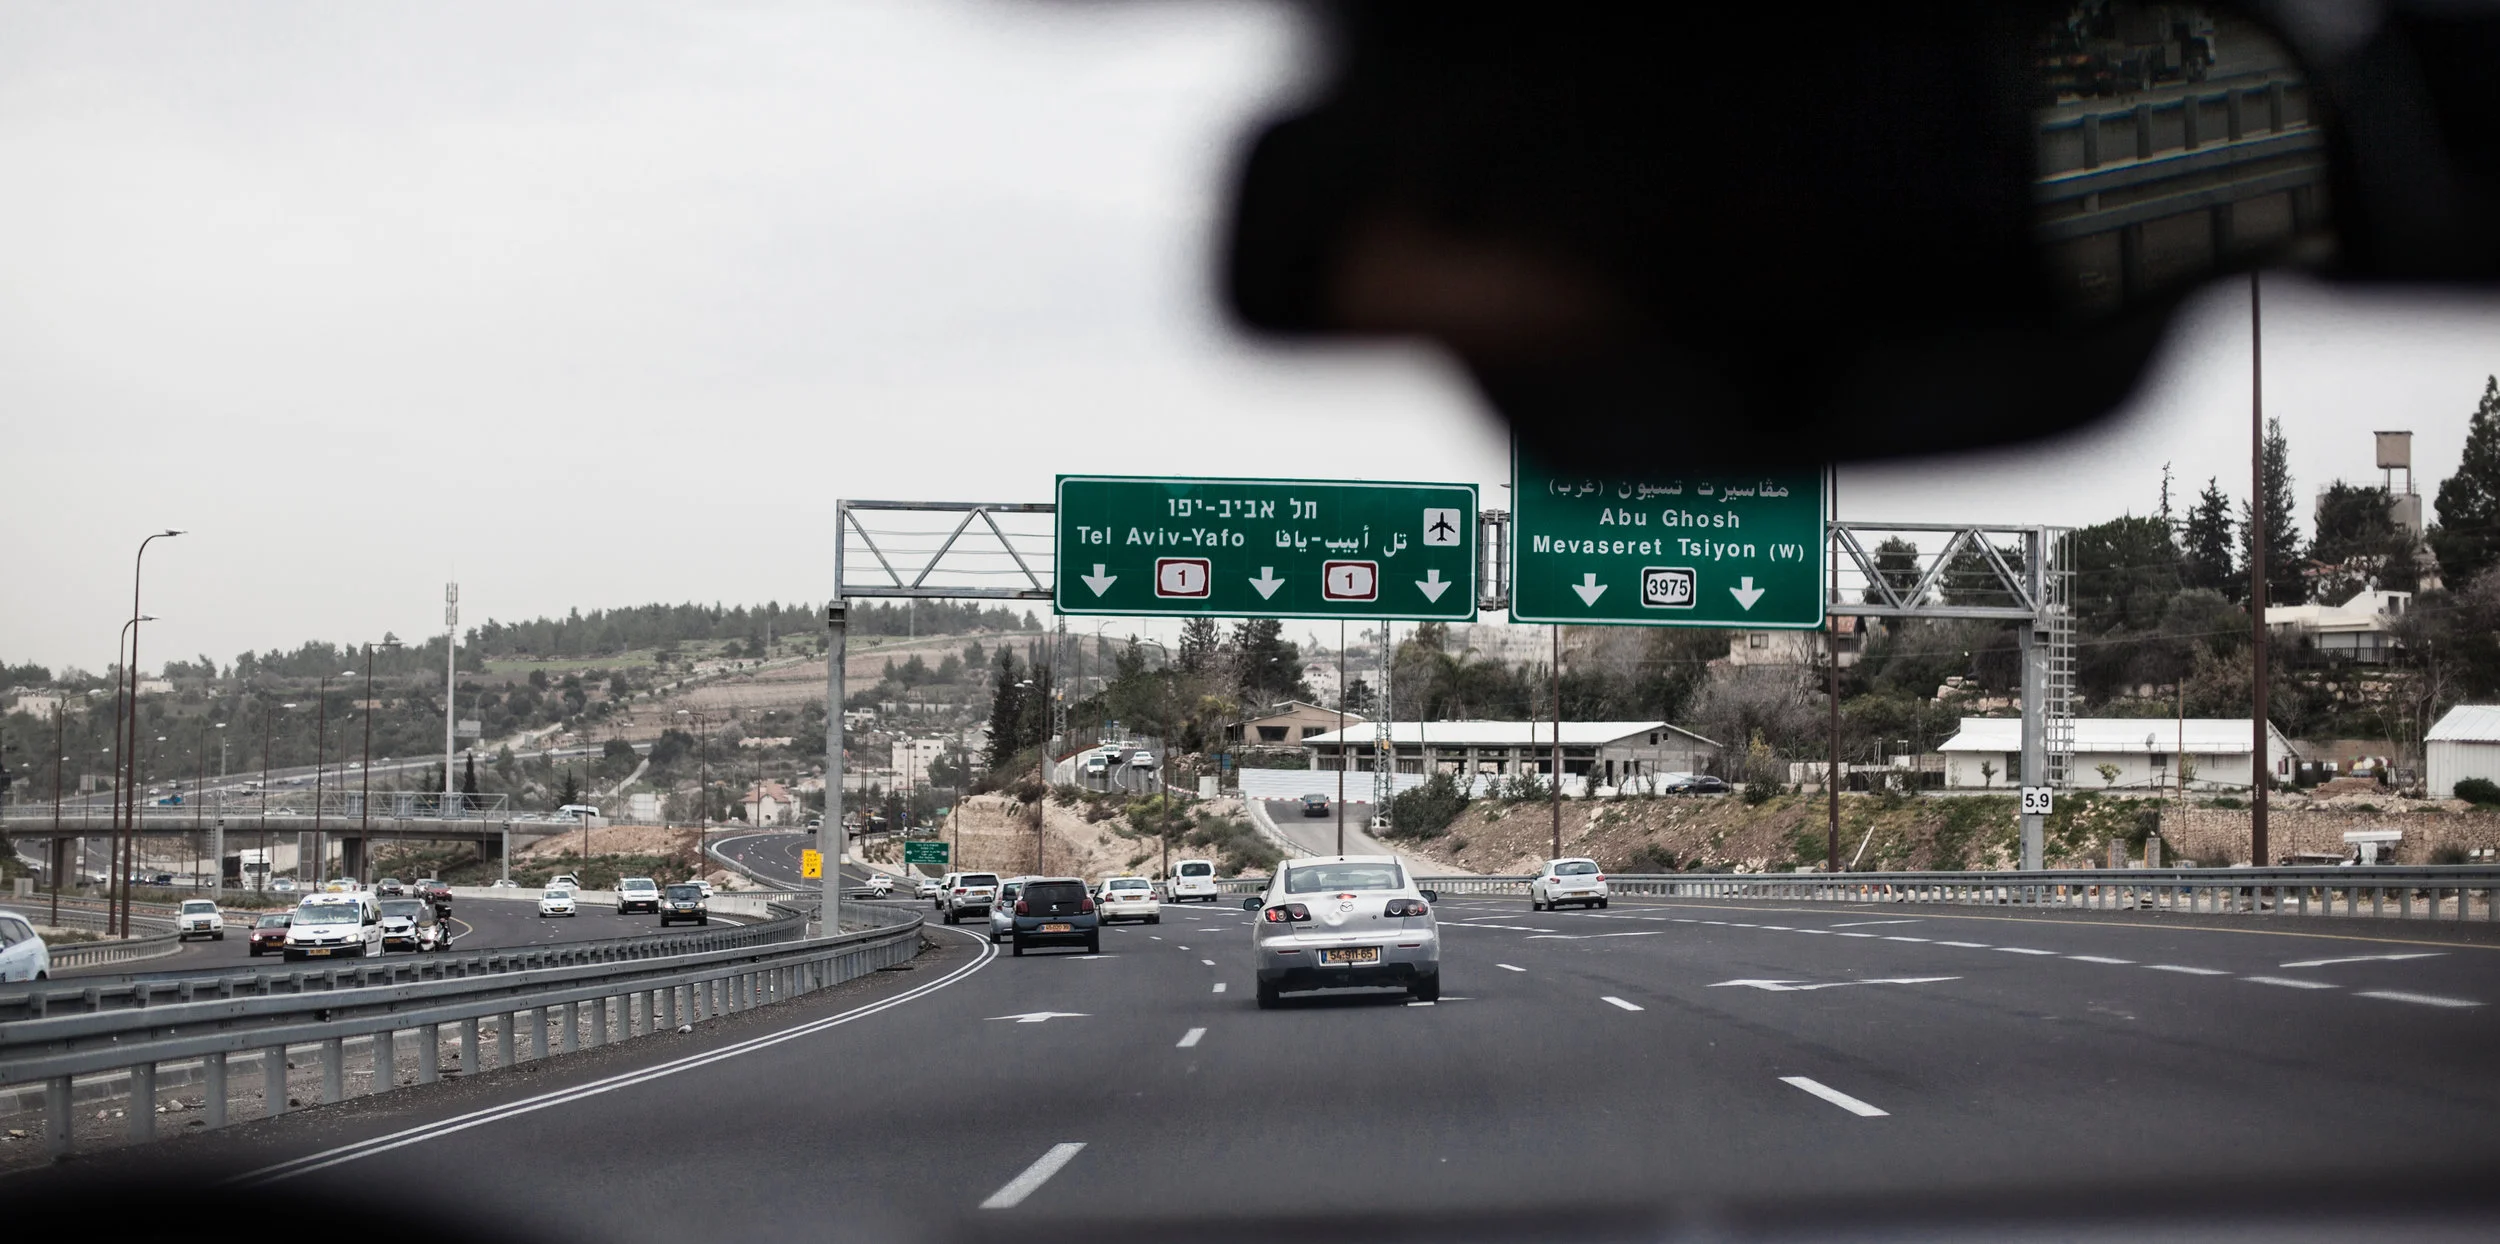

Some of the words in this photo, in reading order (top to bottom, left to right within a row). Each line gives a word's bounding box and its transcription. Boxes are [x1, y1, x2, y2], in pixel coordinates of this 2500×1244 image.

[1618, 479, 1683, 501] تسيون
[1168, 498, 1275, 518] אביב-יפו
[1289, 497, 1317, 519] תל
[1599, 508, 1647, 526] Abu
[1662, 509, 1740, 528] Ghosh
[1077, 526, 1111, 544] Tel
[1126, 527, 1245, 547] Aviv-Yafo
[1275, 524, 1370, 554] أبيب-يافا
[1383, 532, 1408, 557] تل
[1533, 535, 1662, 556] Mevaseret
[1677, 538, 1756, 562] Tsiyon
[1769, 543, 1805, 562] (W)
[1177, 569, 1187, 587] 1
[1344, 572, 1355, 590] 1
[1649, 579, 1689, 597] 3975
[2025, 793, 2050, 807] 5.9
